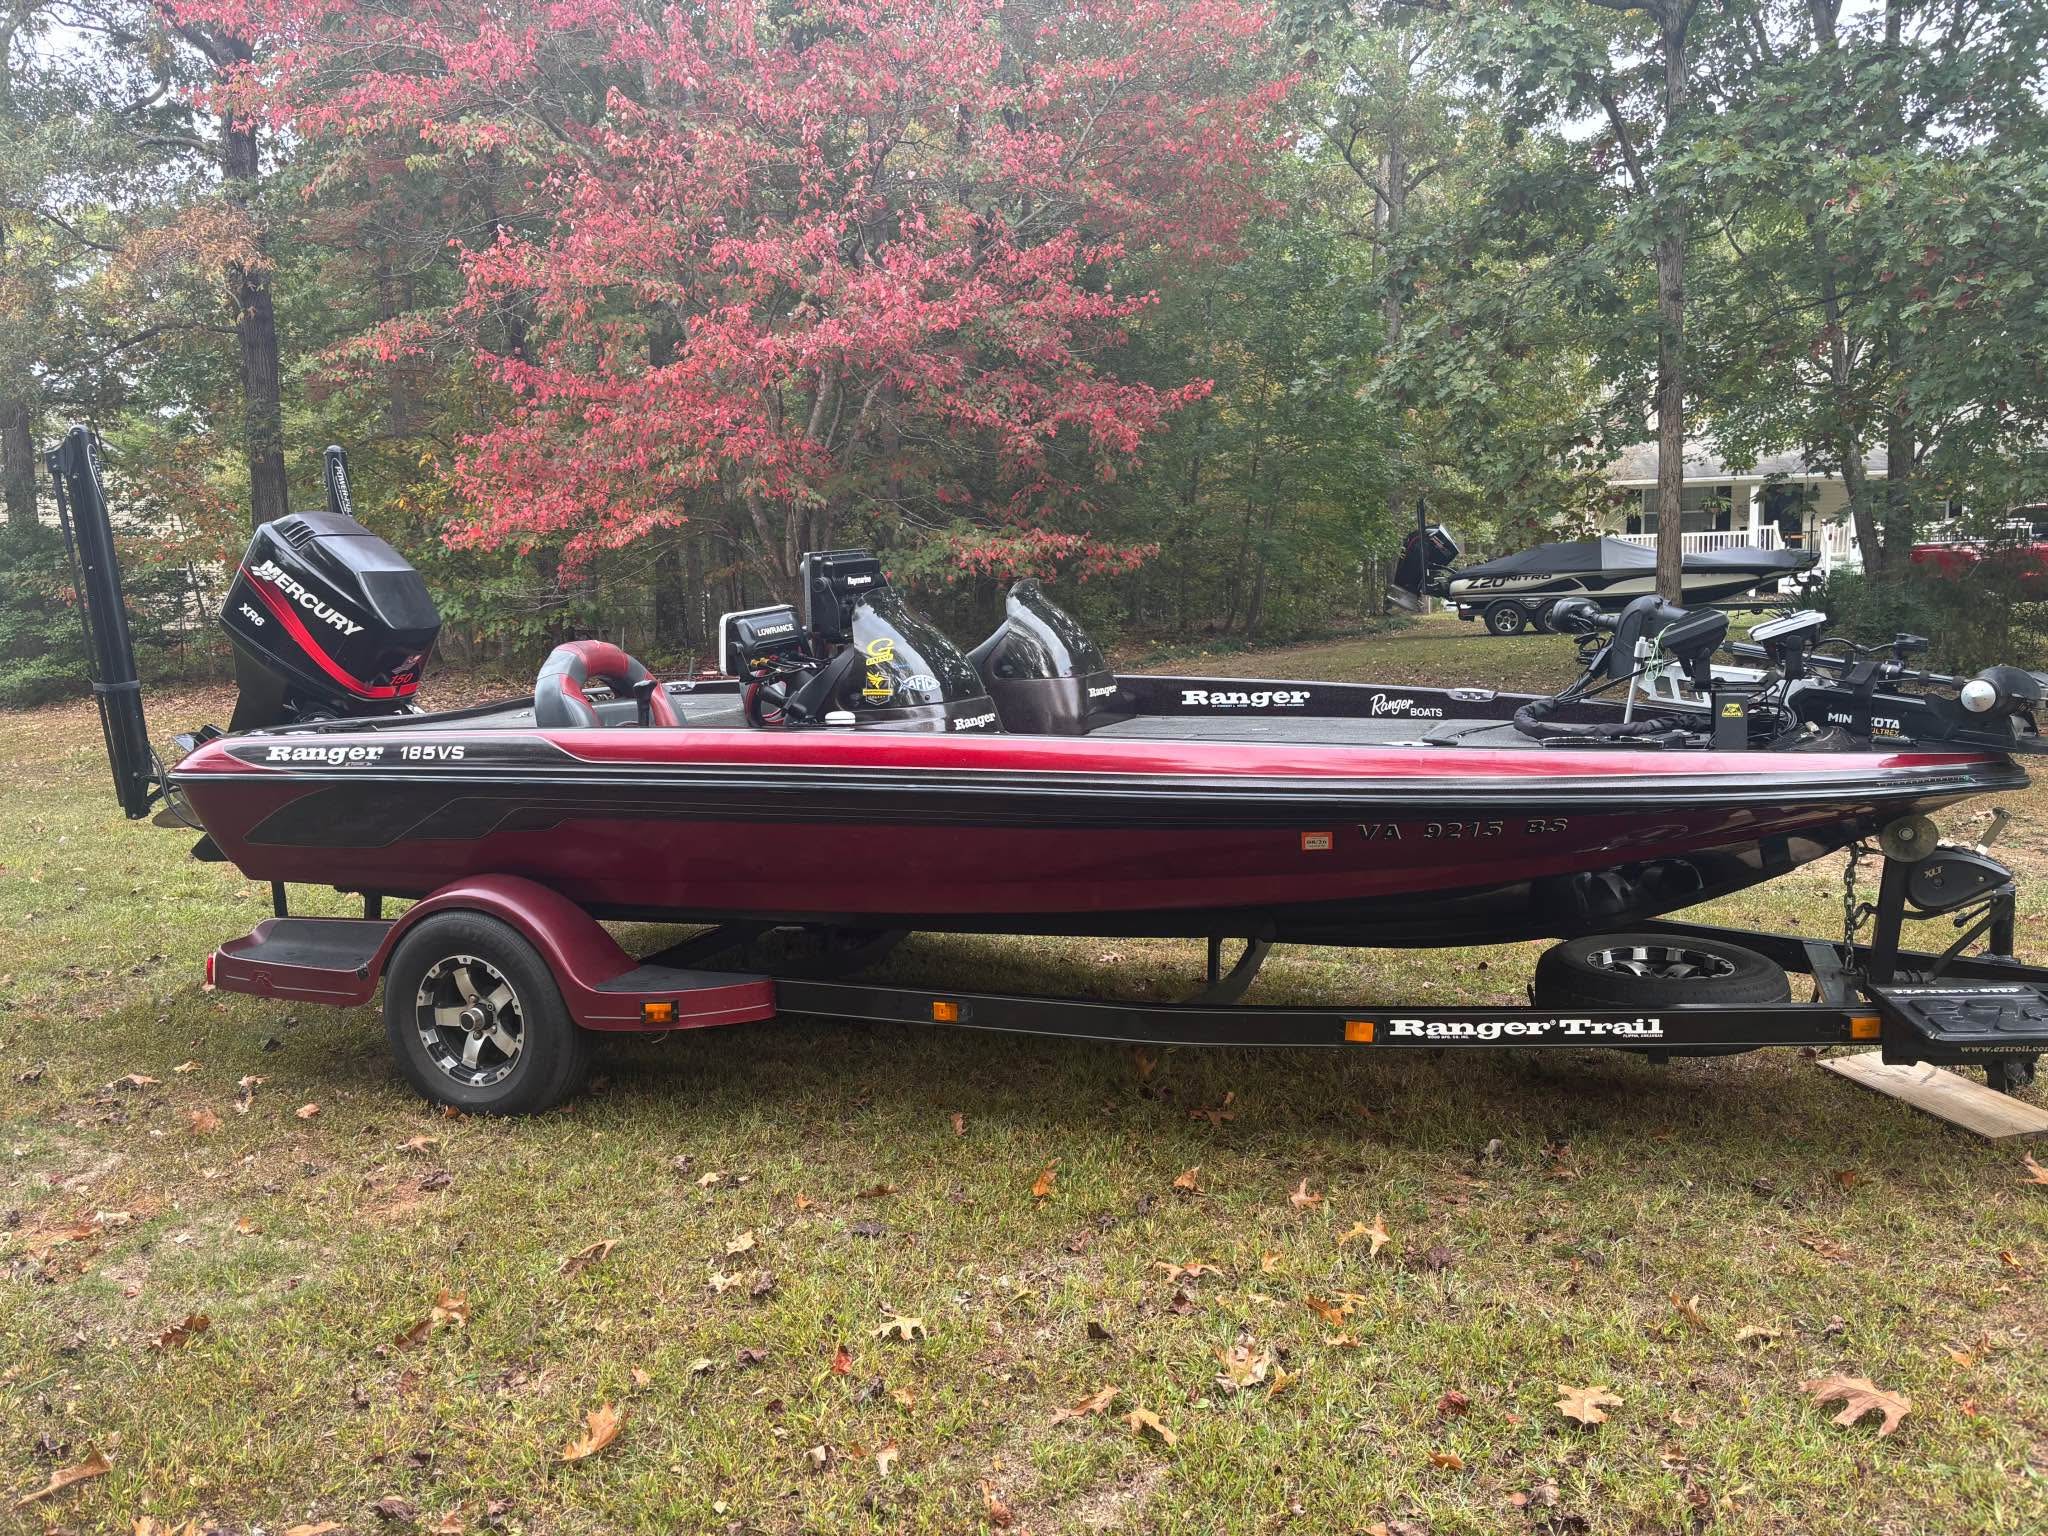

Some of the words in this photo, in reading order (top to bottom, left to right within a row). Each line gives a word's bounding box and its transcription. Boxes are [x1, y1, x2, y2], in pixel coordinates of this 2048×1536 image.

[334, 466, 353, 516] POWER-POL
[847, 575, 872, 586] Raymarine
[1466, 576, 1506, 590] Z20
[1506, 574, 1552, 582] NITRO
[256, 559, 365, 636] MERCURY
[238, 602, 265, 627] XR6
[757, 623, 795, 637] LOWRANCE
[1088, 685, 1117, 698] Ranger
[1181, 690, 1311, 708] Ranger
[1370, 693, 1414, 716] Ranger
[1410, 707, 1443, 717] BOATS
[953, 712, 996, 731] Ranger
[1871, 717, 1900, 729] OTA
[265, 745, 385, 765] Ranger
[400, 745, 465, 760] 185VS
[1357, 823, 1402, 841] VA
[1559, 1018, 1664, 1035] Trail
